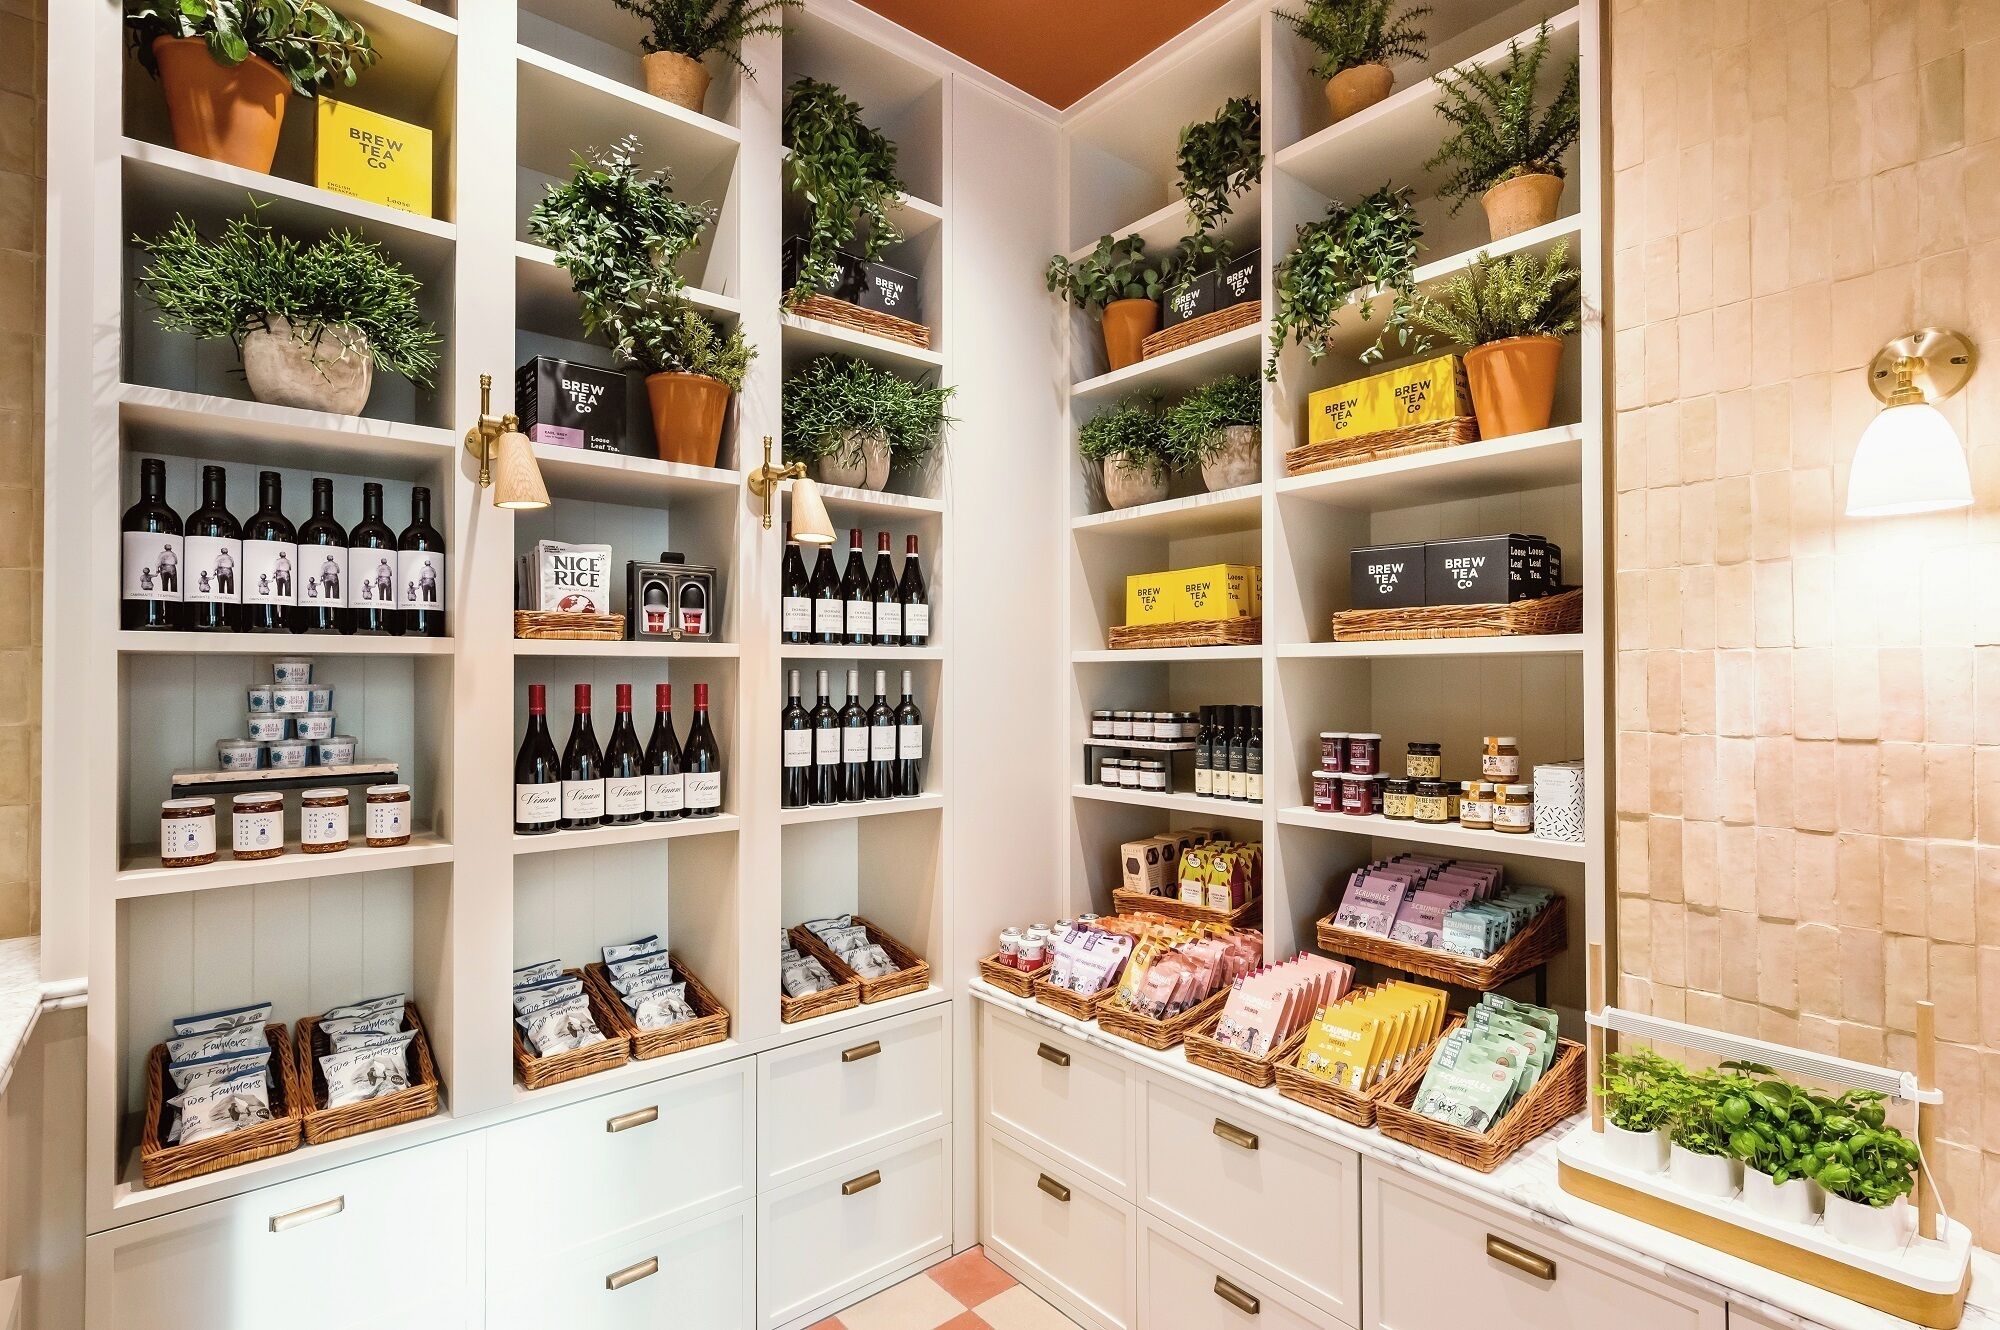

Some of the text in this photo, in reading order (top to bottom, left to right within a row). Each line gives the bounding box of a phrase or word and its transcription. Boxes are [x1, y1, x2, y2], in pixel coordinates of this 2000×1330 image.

[350, 127, 403, 152] BREW
[359, 142, 394, 162] TEA
[367, 158, 387, 169] Co
[327, 182, 351, 191] ENGLISH
[387, 197, 411, 207] Loose
[1226, 265, 1253, 285] BREW
[875, 277, 904, 292] BREW
[1231, 278, 1249, 291] TEA
[880, 286, 899, 300] TEA
[1175, 289, 1200, 305] BREW
[1235, 287, 1246, 297] Co
[884, 297, 895, 306] Co
[1179, 300, 1196, 313] TEA
[1182, 310, 1192, 318] Co
[561, 379, 605, 395] BREW
[1395, 380, 1431, 397] BREW
[569, 391, 597, 405] TEA
[1401, 391, 1426, 405] TEA
[575, 404, 591, 413] Co
[1325, 398, 1358, 415] BREW
[1407, 404, 1420, 414] Co
[1331, 409, 1353, 422] TEA
[1335, 421, 1348, 430] Co
[590, 435, 610, 444] Loose
[590, 442, 605, 450] Leaf
[1510, 546, 1526, 557] Loose
[1528, 546, 1544, 556] Loose
[554, 556, 600, 572] NICE
[1445, 556, 1486, 569] BREW
[1510, 558, 1523, 568] Leaf
[1529, 558, 1542, 568] Leaf
[1368, 563, 1404, 575] BREW
[1451, 568, 1479, 580] TEA
[1510, 570, 1522, 580] Tea.
[1529, 570, 1542, 579] Tea.
[554, 571, 599, 588] RICE
[1227, 572, 1244, 581] Loose
[1374, 573, 1398, 584] TEA
[1185, 582, 1211, 593] BREW
[1228, 582, 1240, 590] Leaf
[1379, 583, 1393, 594] Co
[1457, 579, 1472, 590] Co
[1137, 587, 1161, 597] BREW
[1190, 591, 1207, 600] TEA
[1142, 596, 1157, 604] TEA
[1194, 600, 1204, 608] Co
[1144, 604, 1153, 612] Co
[610, 785, 643, 798] Vinum
[650, 782, 681, 795] Vinum
[689, 780, 719, 792] Vinum
[521, 791, 557, 805] Vinum
[566, 787, 600, 801] Vinum
[1354, 889, 1390, 902] SCRUMBLES
[1411, 902, 1445, 915] SCRUMBLE
[1444, 919, 1482, 932] SCRUMBLES
[1321, 1022, 1361, 1041] SCRUMBLES
[1438, 1071, 1492, 1092] SCRUMBLES
[210, 1080, 261, 1101] Farmers
